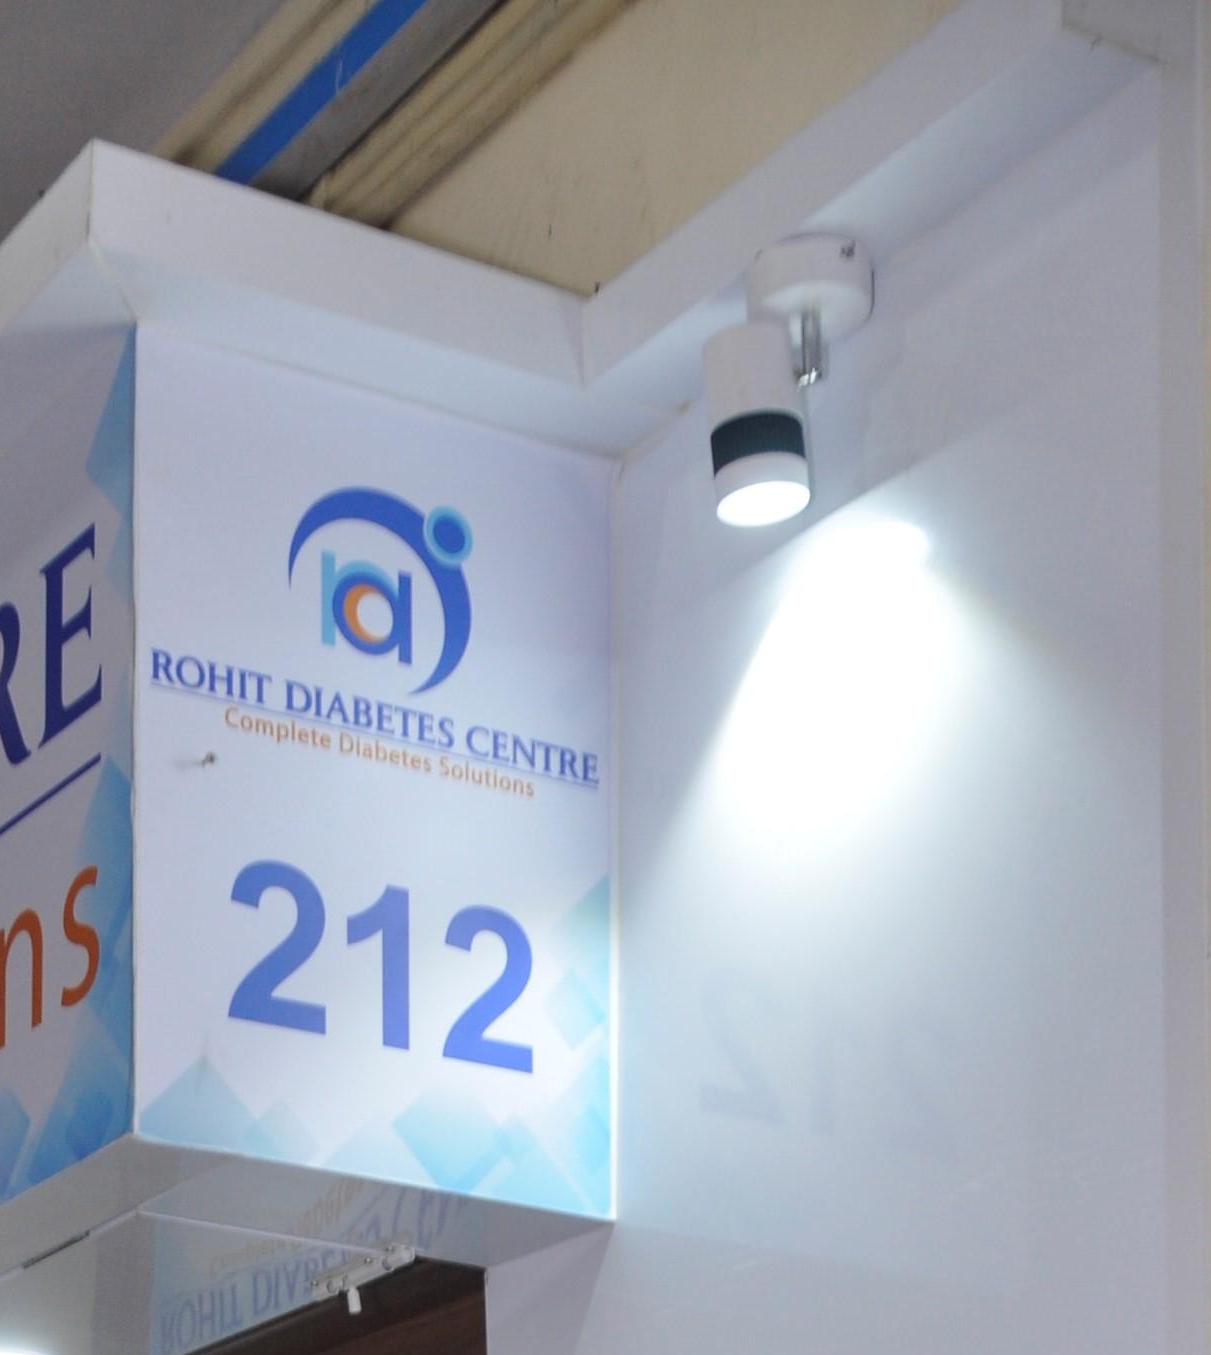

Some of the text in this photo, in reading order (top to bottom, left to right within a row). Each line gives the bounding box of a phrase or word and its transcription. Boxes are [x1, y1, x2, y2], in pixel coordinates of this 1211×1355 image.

[150, 648, 600, 786] ROHIT DIABETES CENTRE
[224, 706, 536, 798] Complete Diabetes Solutions
[227, 859, 533, 1074] 212
